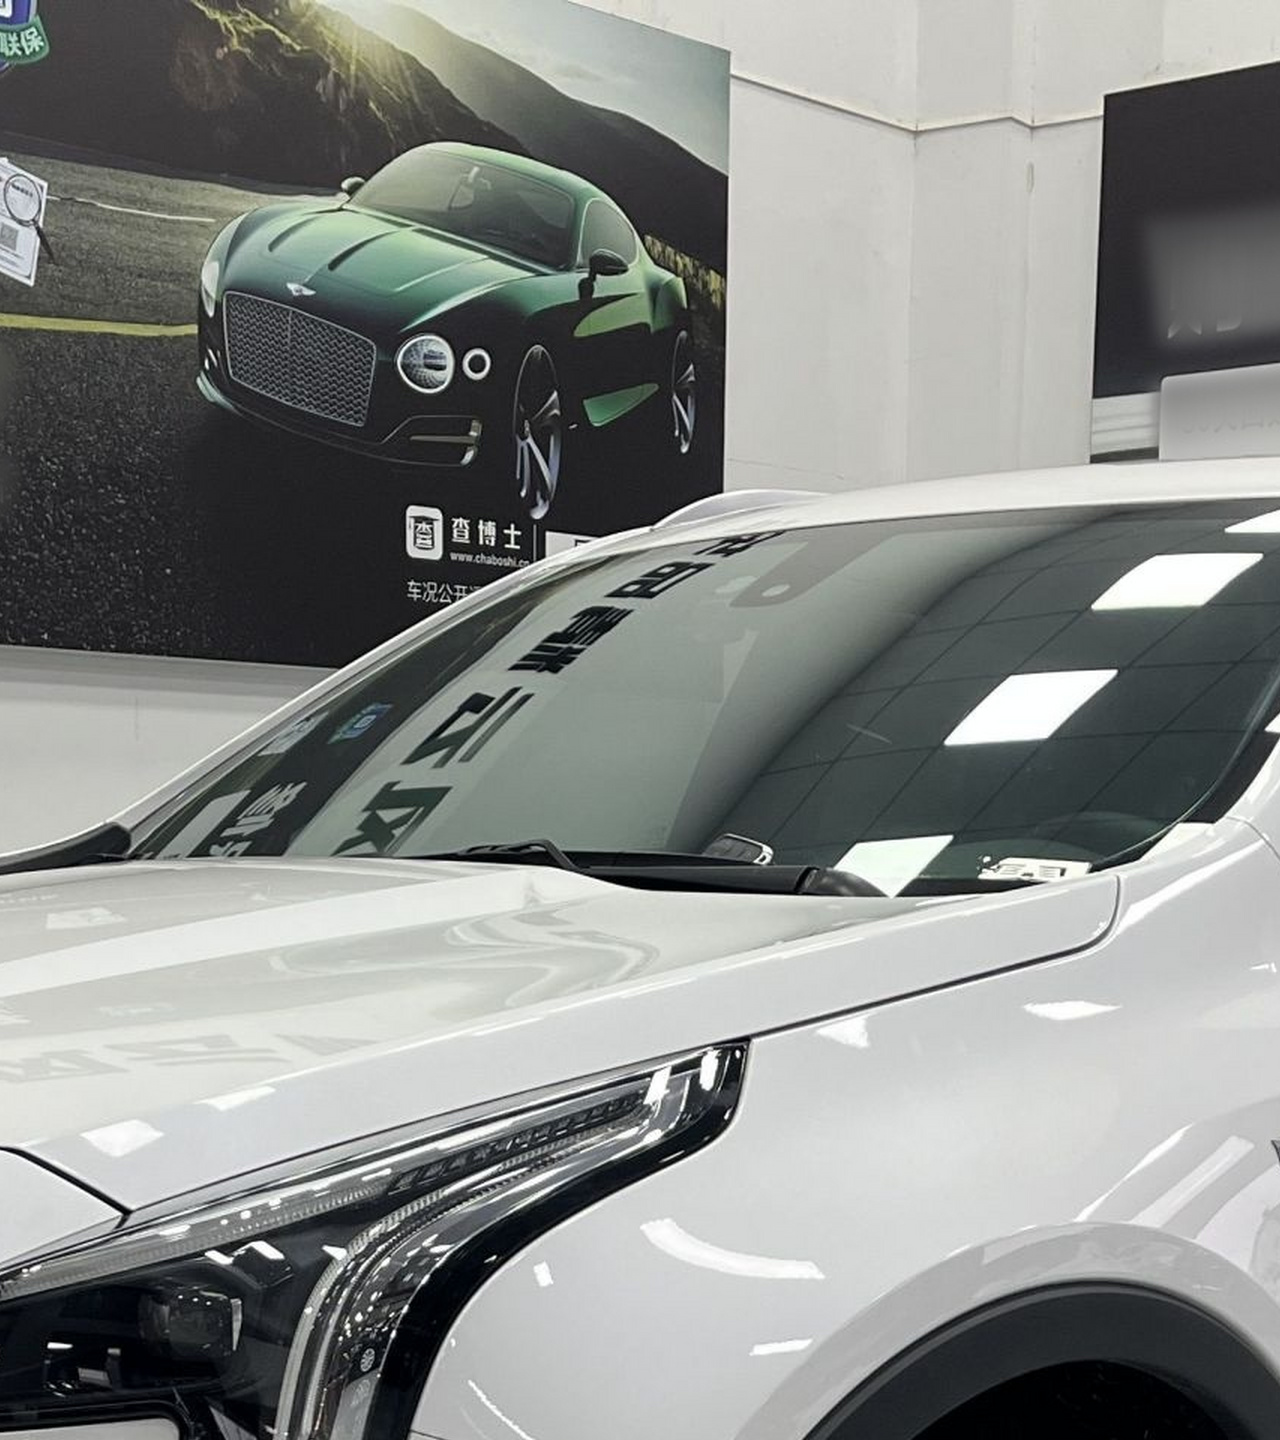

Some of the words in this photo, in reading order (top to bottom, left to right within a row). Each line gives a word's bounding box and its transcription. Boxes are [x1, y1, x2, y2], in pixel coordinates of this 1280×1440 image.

[451, 516, 522, 550] 查博士
[406, 579, 482, 604] 车况公开
